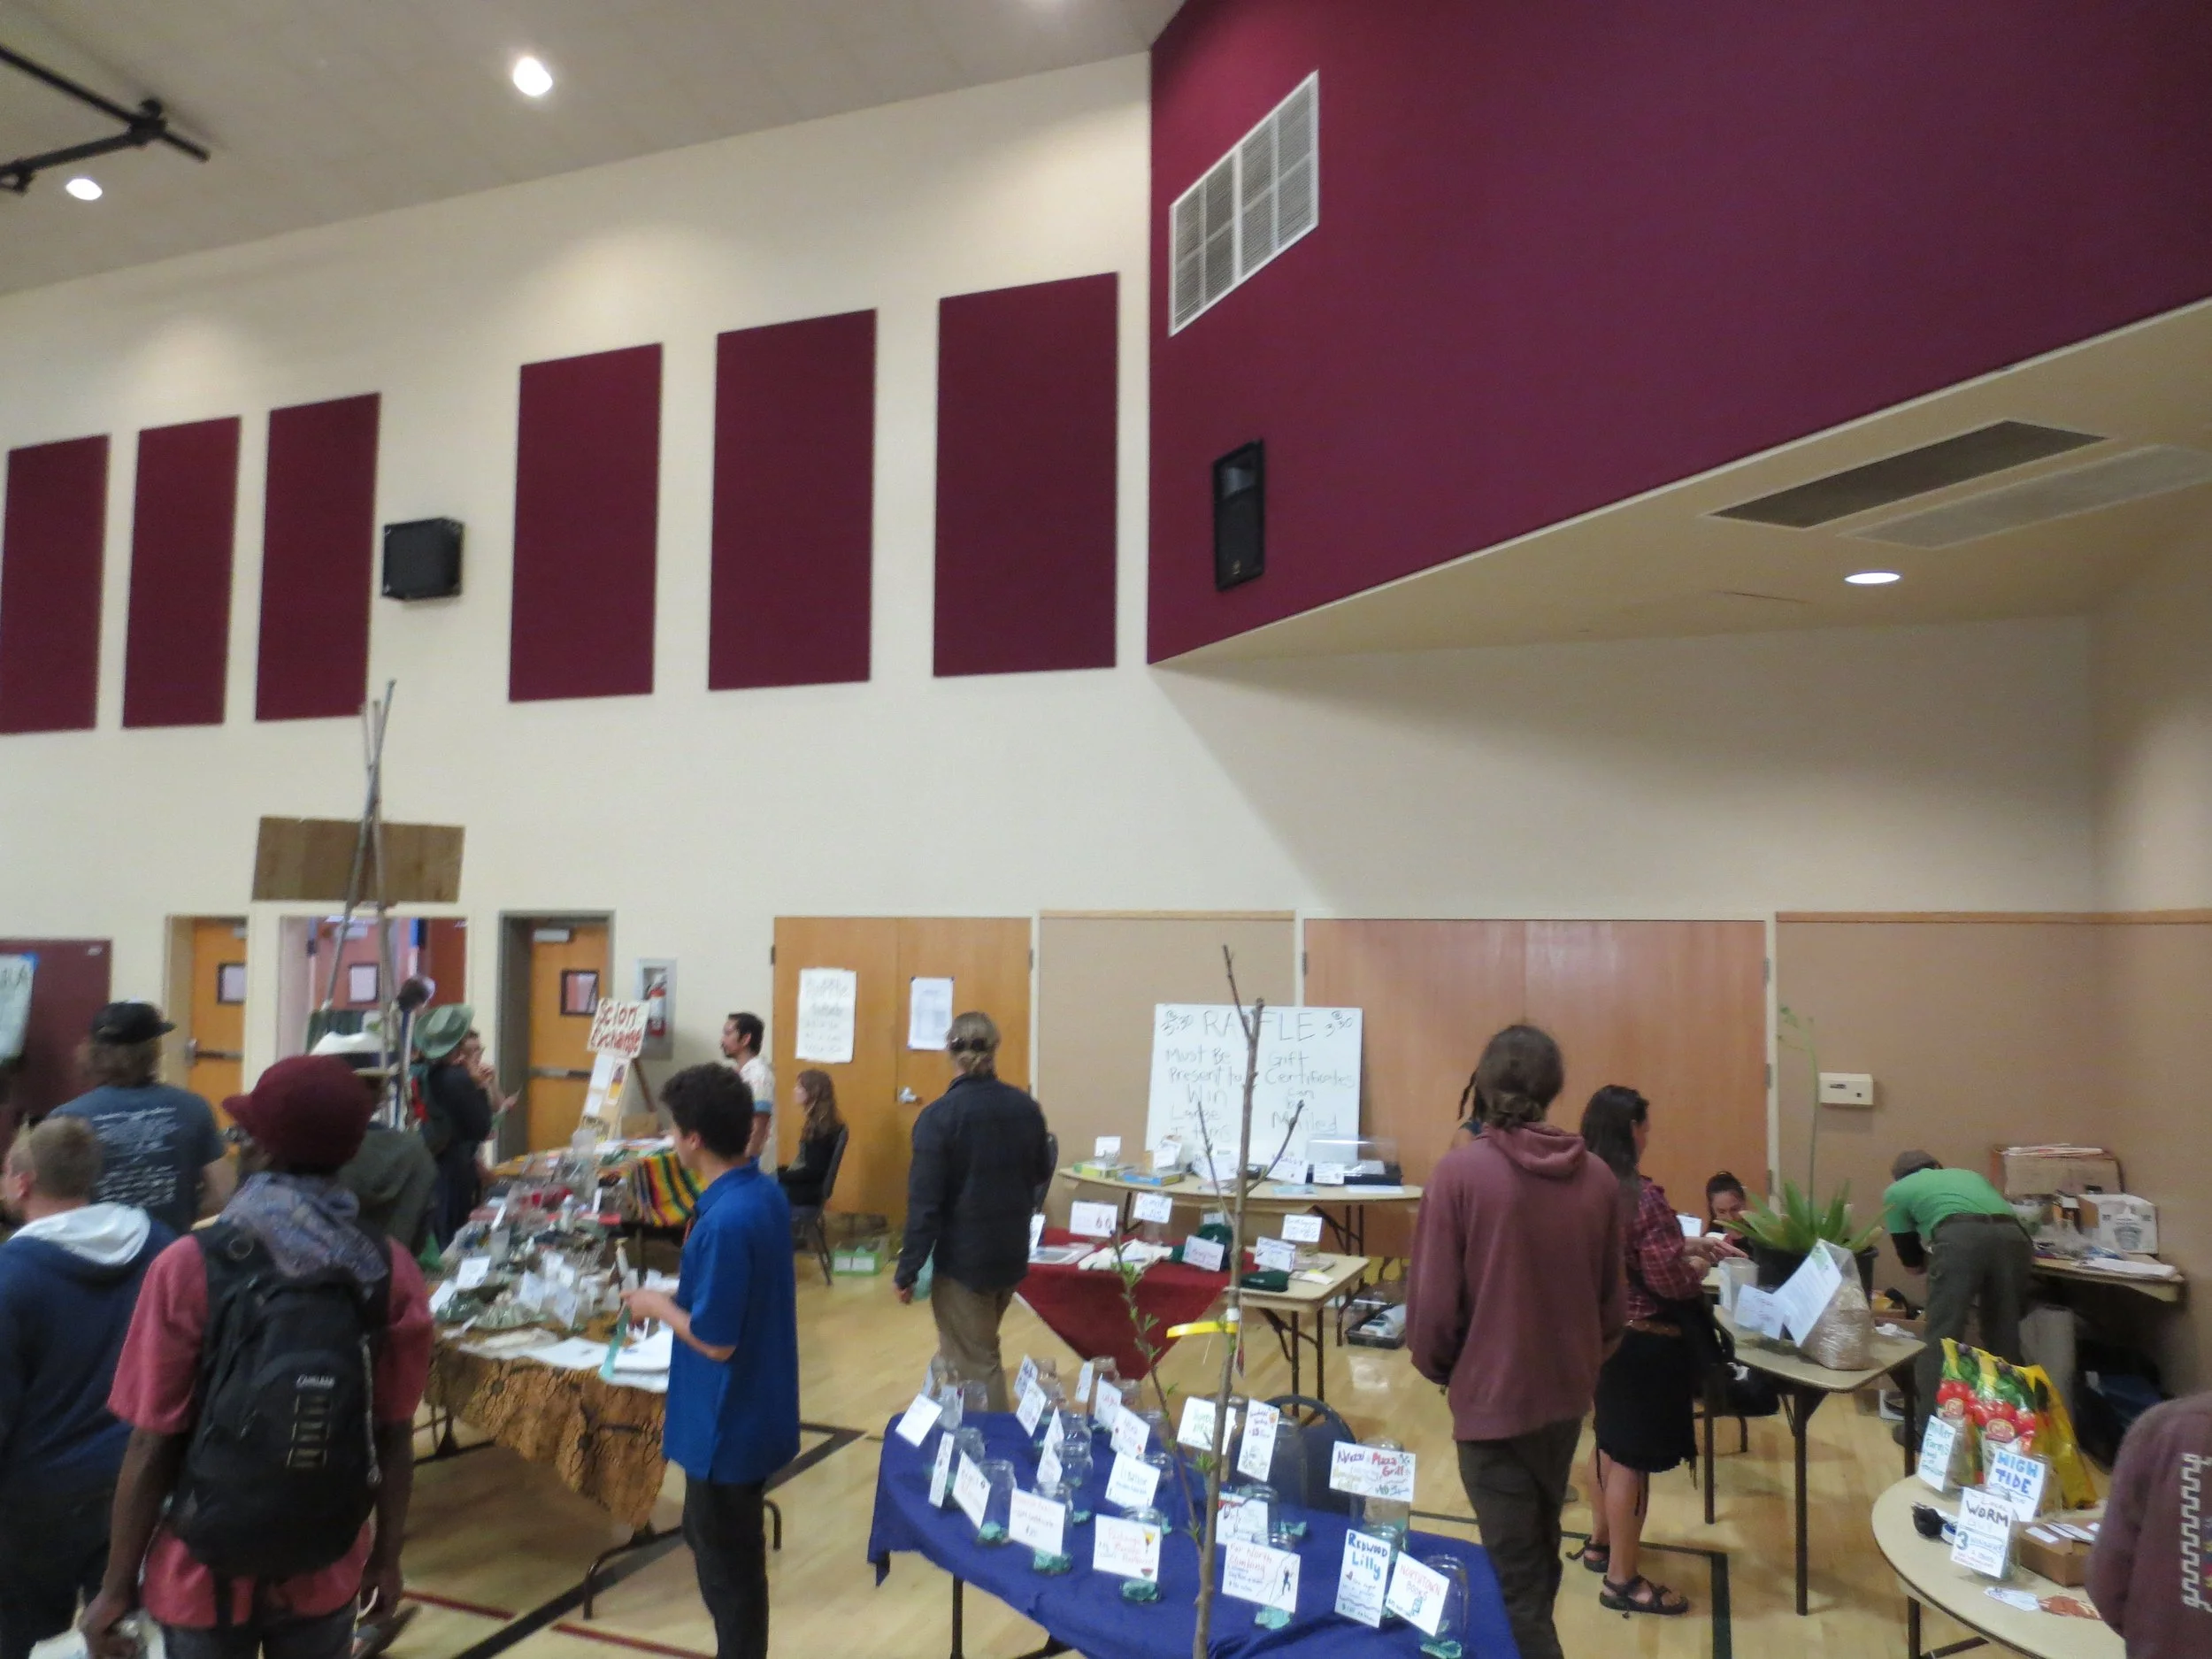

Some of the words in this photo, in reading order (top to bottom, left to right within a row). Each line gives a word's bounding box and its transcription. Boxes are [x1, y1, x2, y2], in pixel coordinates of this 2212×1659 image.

[1204, 1010, 1316, 1041] RAFLE
[1997, 1451, 2038, 1478] HIGH
[1995, 1468, 2032, 1494] TIDE
[1966, 1500, 2008, 1528] WORM
[1351, 1552, 1381, 1581] Lilly
